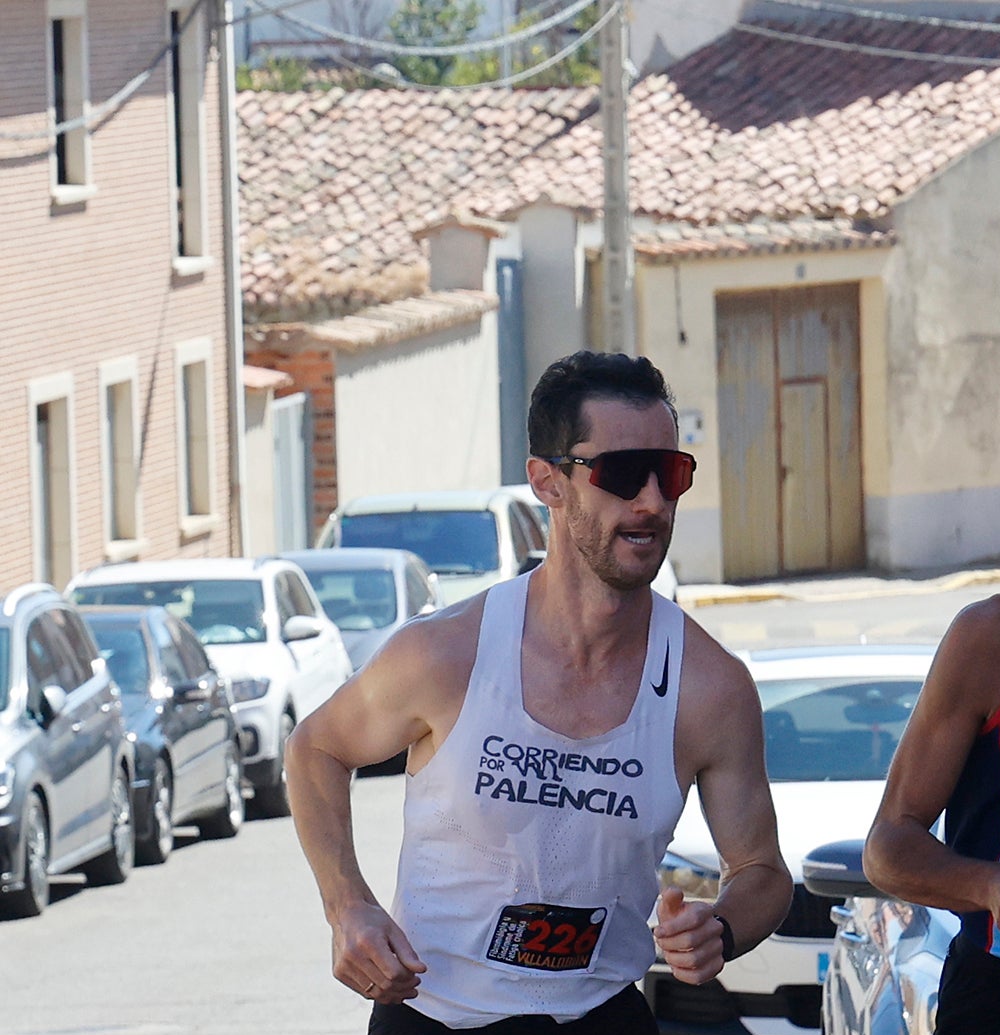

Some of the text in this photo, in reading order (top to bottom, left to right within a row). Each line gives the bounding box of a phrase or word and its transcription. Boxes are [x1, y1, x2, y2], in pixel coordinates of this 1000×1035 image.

[479, 756, 505, 772] POR
[482, 735, 643, 781] CORRIENDO
[475, 771, 638, 820] PALENCIA
[521, 920, 599, 954] 226
